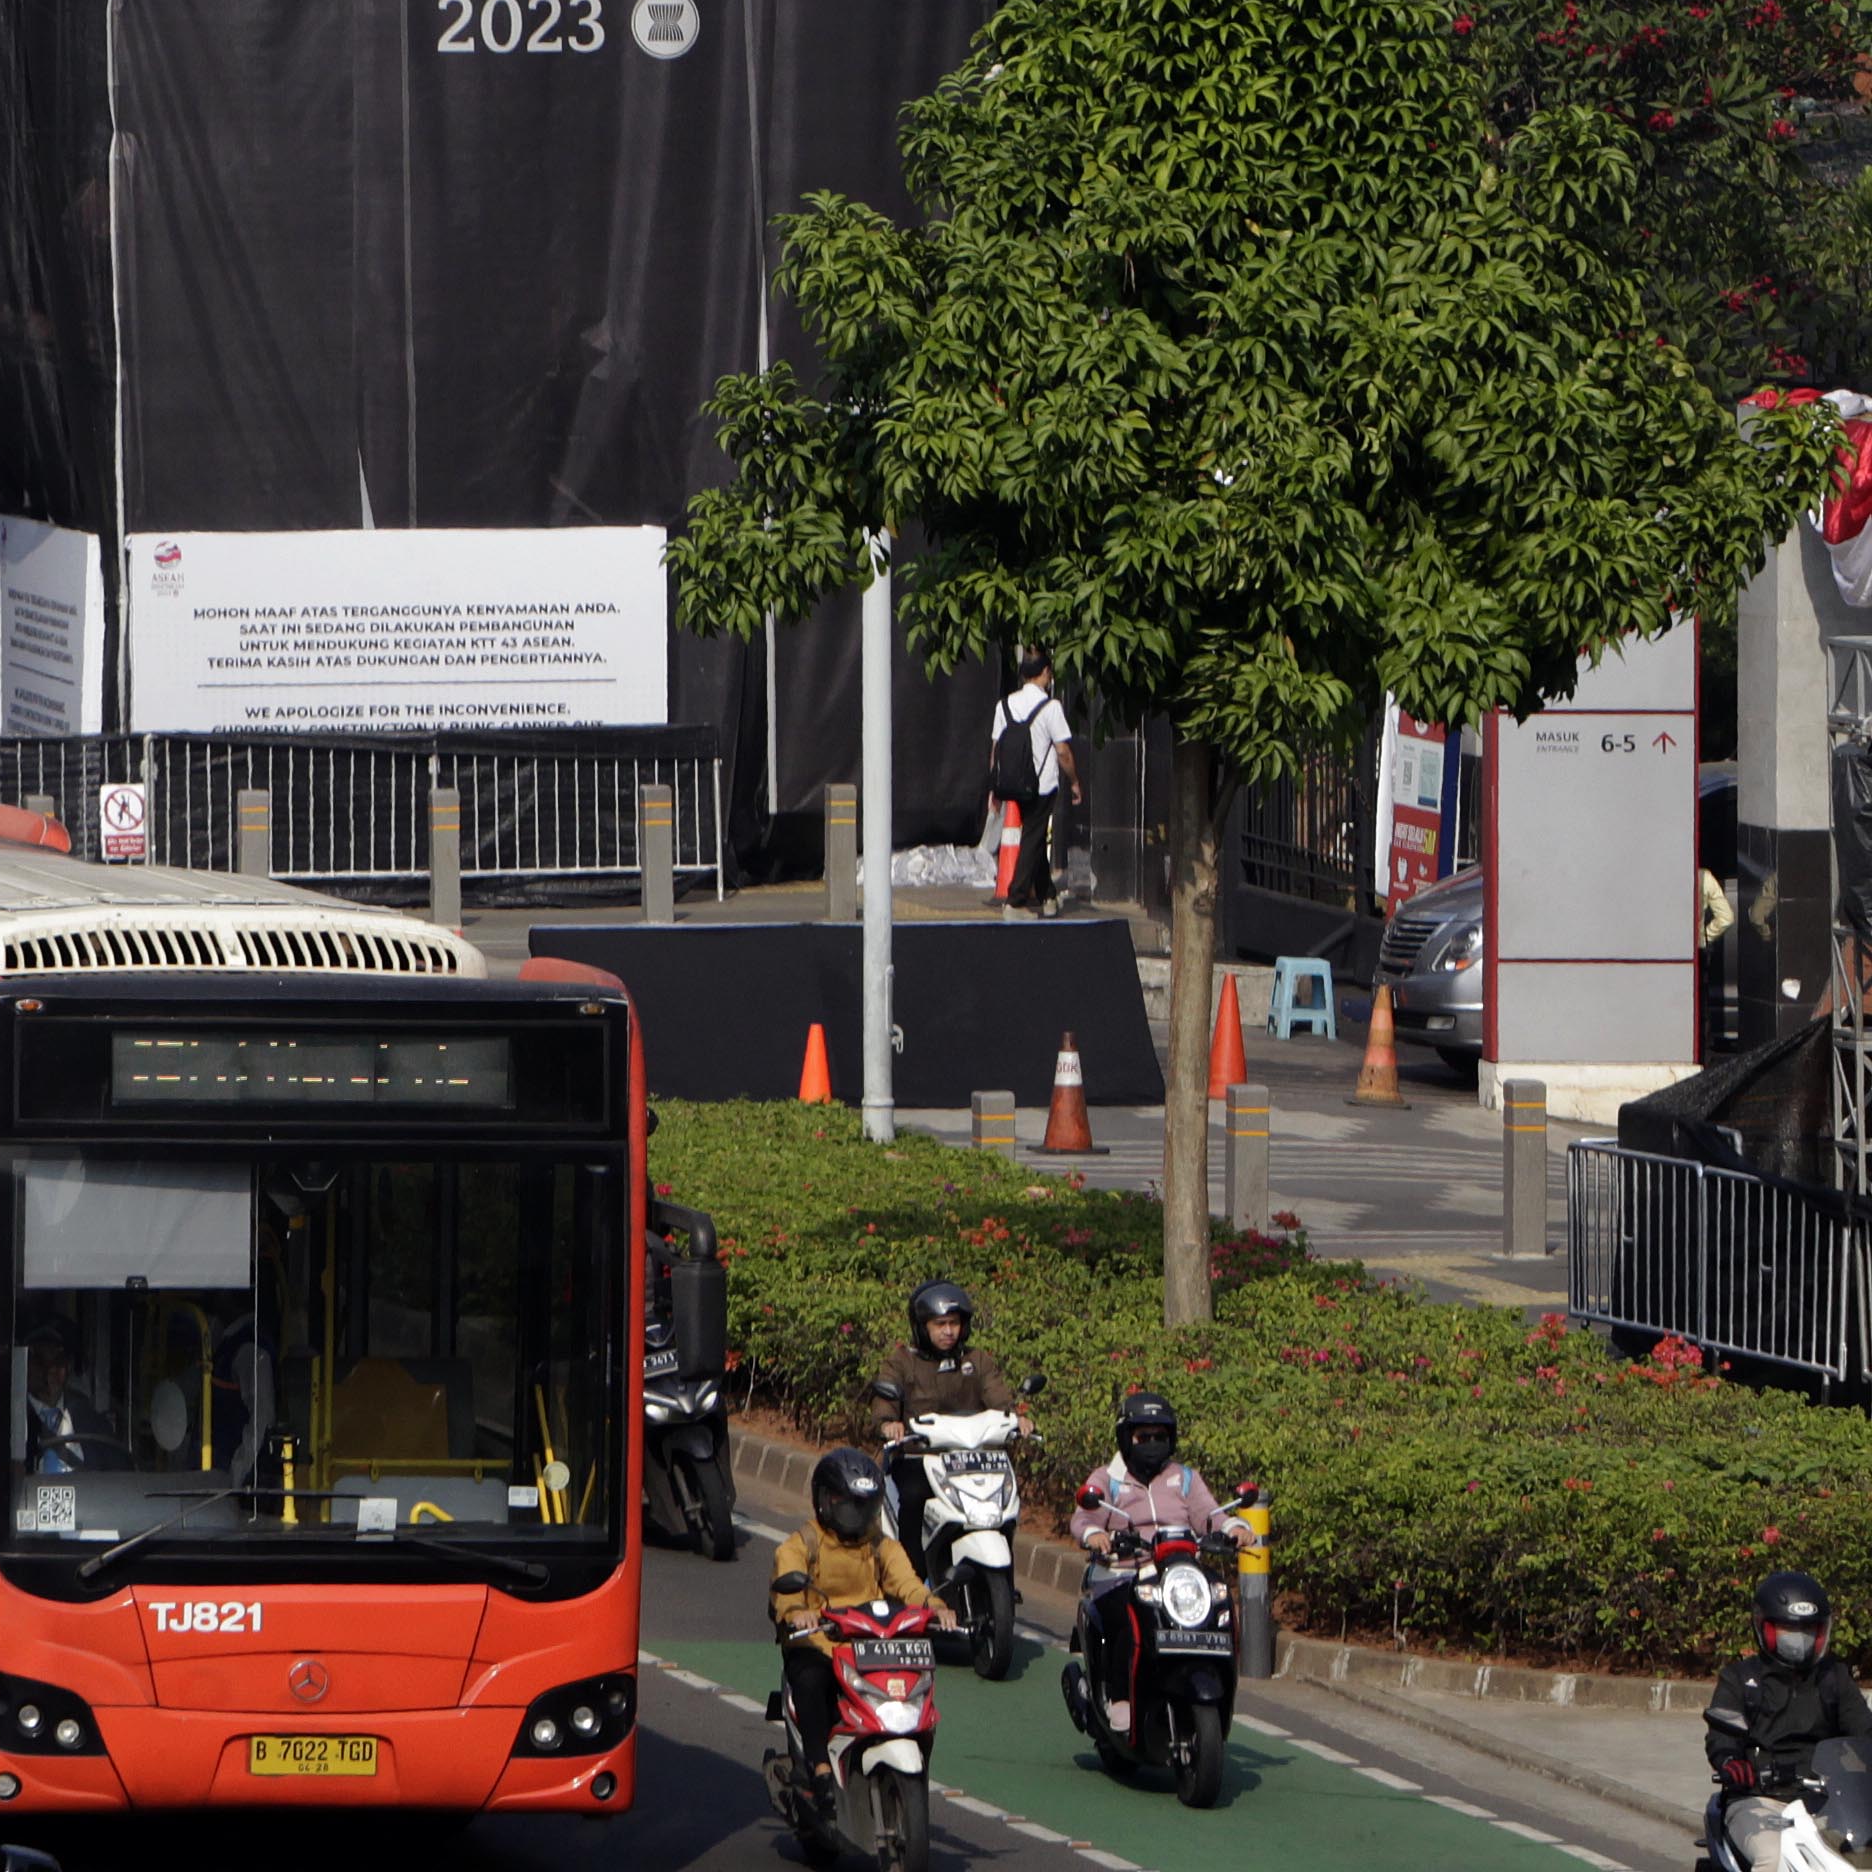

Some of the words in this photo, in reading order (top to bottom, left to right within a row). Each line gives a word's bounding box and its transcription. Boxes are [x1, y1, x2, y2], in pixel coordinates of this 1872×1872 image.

[194, 607, 250, 620] MOHON
[255, 606, 297, 619] MAAF
[301, 605, 337, 618] ATAS
[342, 605, 462, 618] TERGANGGUNYA
[466, 603, 570, 616] KENYAMANAN
[575, 602, 621, 614] ANDA.
[240, 624, 277, 635] SAAT
[281, 623, 301, 635] INI
[305, 622, 366, 634] SEDANG
[370, 621, 455, 633] DILAKUKAN
[460, 619, 575, 632] PEMBANGUNAN
[240, 640, 289, 652] UNTUK
[293, 639, 389, 651] MENDUKUNG
[394, 638, 466, 650] KEGIATAN
[471, 637, 497, 649] KTT
[501, 637, 518, 648] 43
[522, 636, 575, 648] ASEAN.
[208, 657, 262, 670] TERIMA
[267, 656, 310, 669] KASIH
[315, 655, 351, 667] ATAS
[356, 655, 440, 667] DUKUNGAN
[444, 654, 476, 666] DAN
[480, 652, 607, 665] PENGERTIANNYA.
[245, 706, 271, 719] WE
[275, 705, 364, 719] APOLOGIZE
[369, 704, 400, 717] FOR
[405, 704, 435, 716] THE
[439, 702, 571, 716] INCONVENIENCE.
[1536, 731, 1580, 743] MASUK
[1601, 733, 1636, 753] 6-5
[148, 1602, 262, 1632] TJ821
[256, 1740, 267, 1761] B
[280, 1740, 329, 1761] 7022
[338, 1740, 373, 1762] TGD
